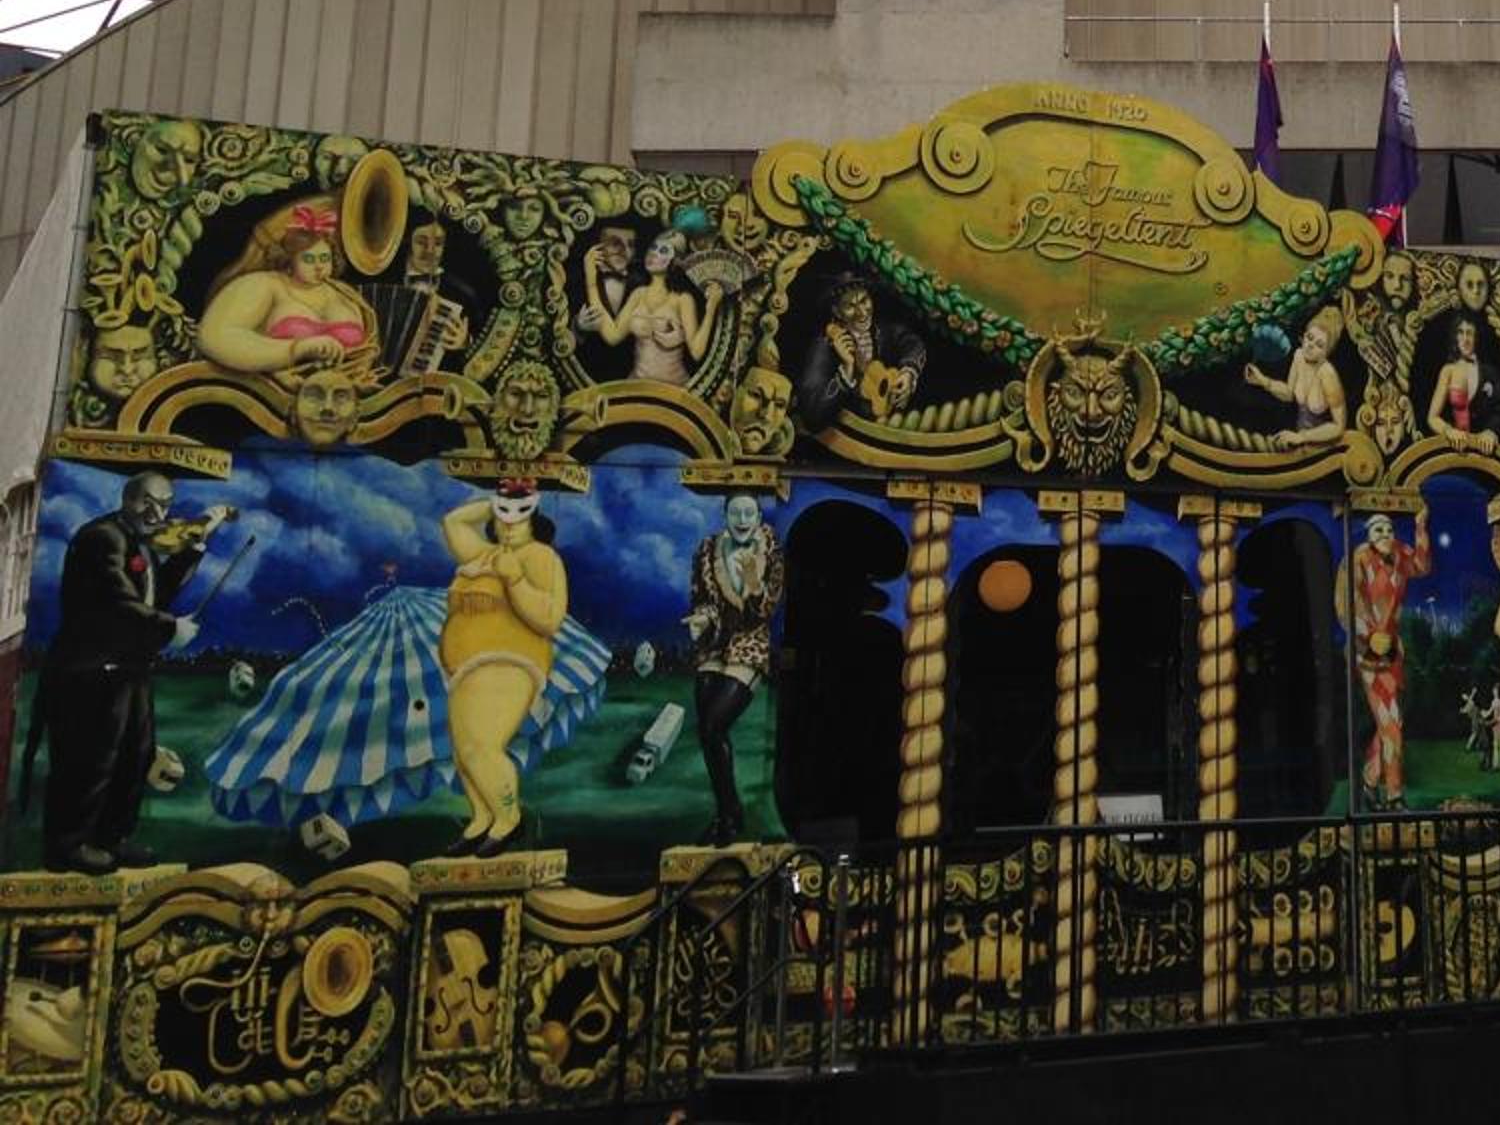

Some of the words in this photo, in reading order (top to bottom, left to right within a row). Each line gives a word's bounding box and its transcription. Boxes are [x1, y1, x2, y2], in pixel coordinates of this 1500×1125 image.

[1034, 90, 1089, 113] ANNO
[1106, 98, 1148, 123] 1920
[1047, 166, 1088, 194] The
[1080, 161, 1173, 207] Famous
[962, 191, 1213, 271] Spiegeltent
